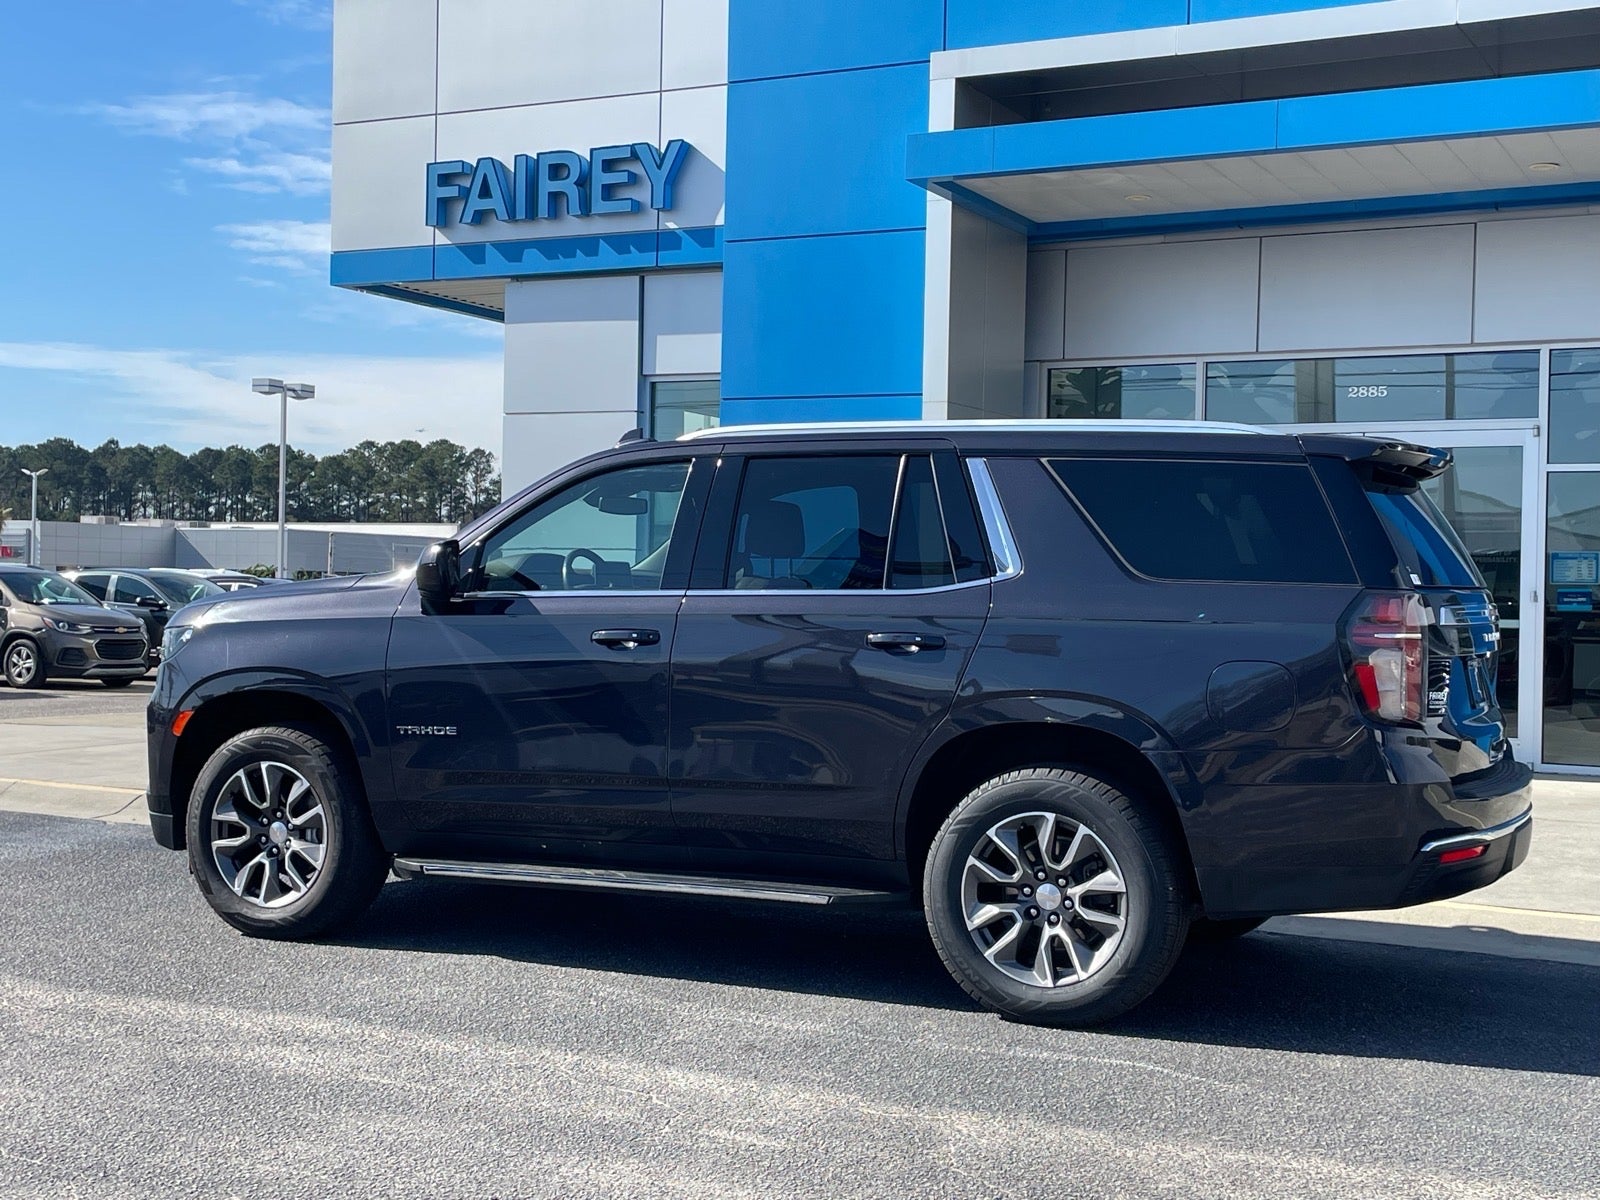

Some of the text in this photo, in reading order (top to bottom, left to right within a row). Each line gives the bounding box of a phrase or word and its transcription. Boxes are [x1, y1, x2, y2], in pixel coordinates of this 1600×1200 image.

[426, 139, 690, 227] FAIREY
[1347, 385, 1388, 398] 2885
[396, 725, 457, 735] TAHOE
